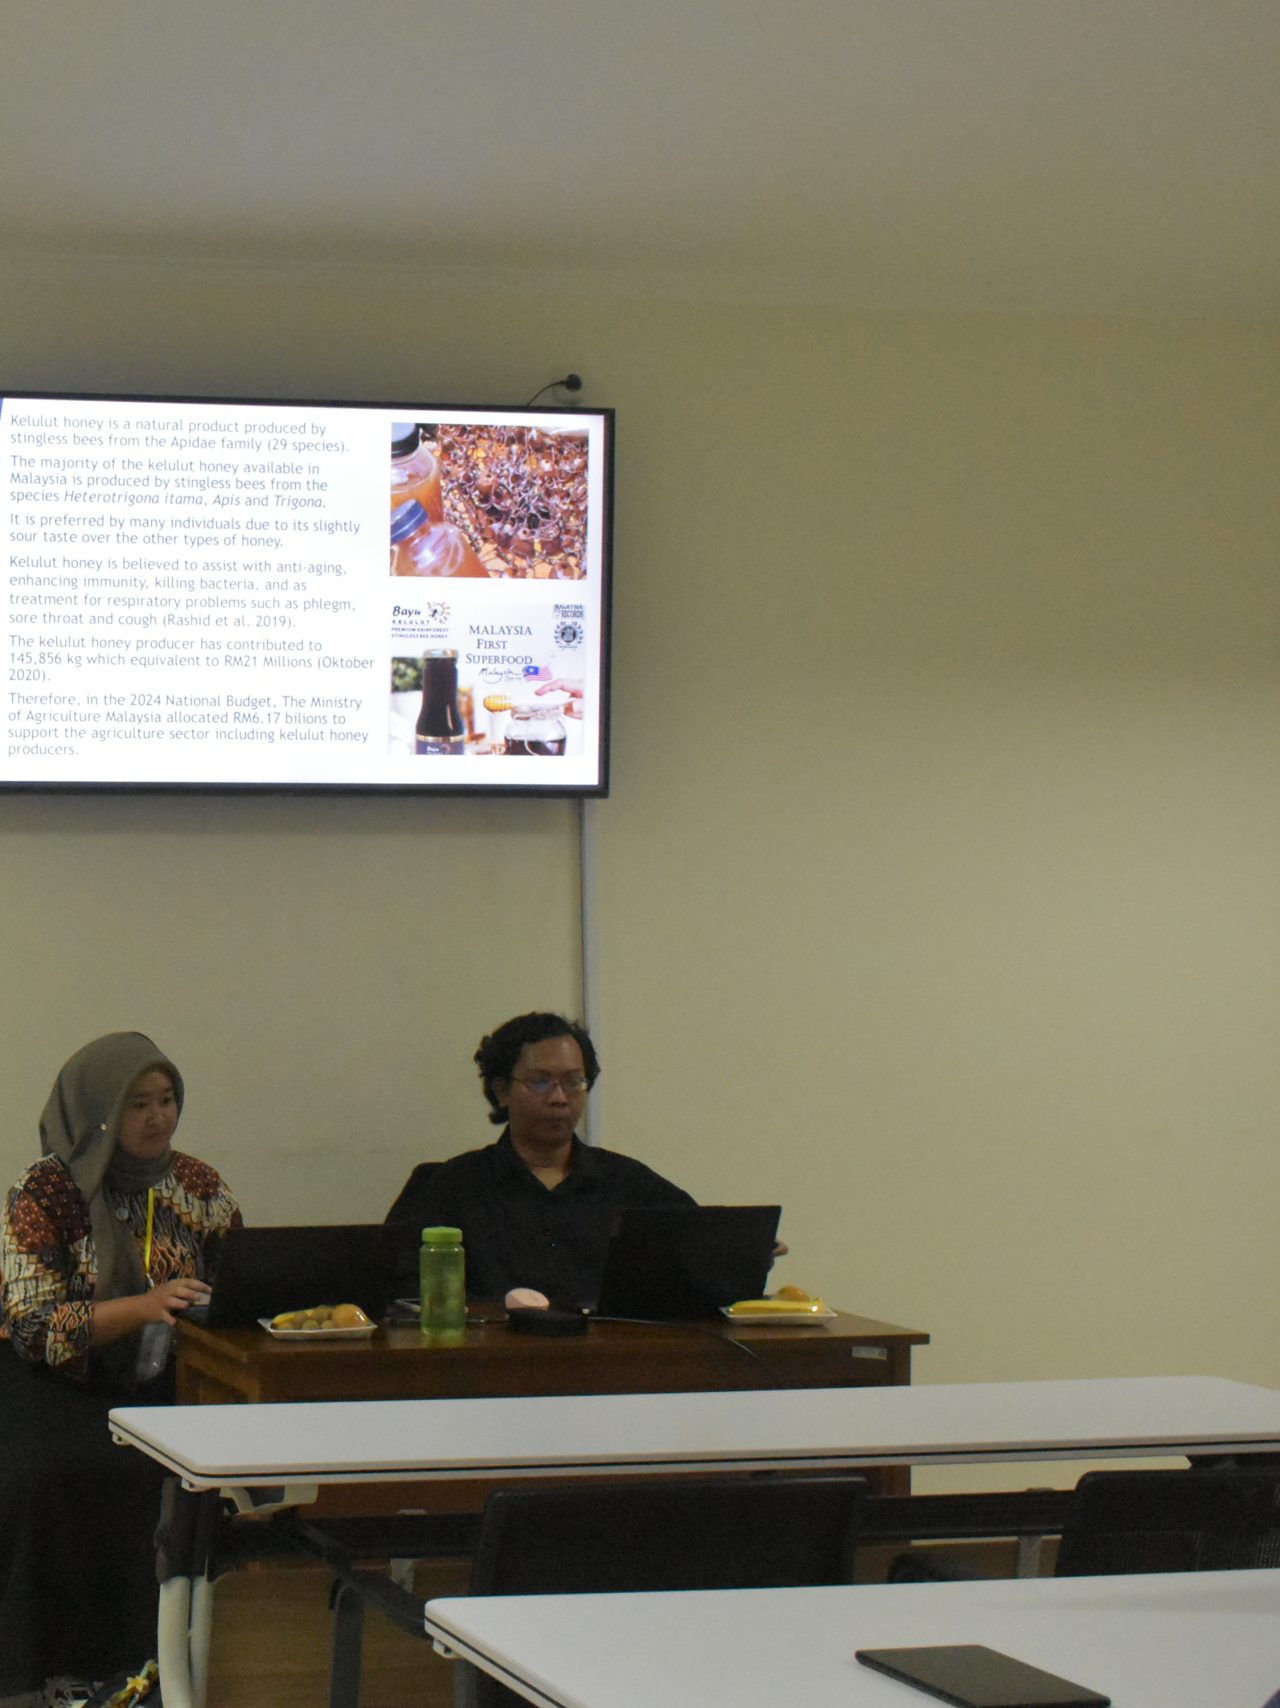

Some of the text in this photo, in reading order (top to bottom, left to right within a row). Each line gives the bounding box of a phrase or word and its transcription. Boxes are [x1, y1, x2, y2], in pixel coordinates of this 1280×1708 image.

[10, 414, 326, 438] Kelulut honey is a natural product produced by
[10, 431, 350, 455] stingless bees from the Apidae family (29 species).
[10, 455, 320, 475] The majority of the kelulut honey available in
[9, 472, 328, 492] Malaysia is produced by stingless bees from the
[9, 489, 327, 511] species Heterotrigona itama, Apis and Trigona.
[10, 513, 360, 535] It is preferred by many individuals due to its slightly
[9, 532, 284, 550] sour taste over the other types of honey.
[9, 556, 347, 576] Kelulut honey is believed to assist with anti-aging,
[9, 574, 307, 592] enhancing immunity, killing bacteria, and as
[9, 594, 355, 613] treatment for respiratory problems such as phlegm,
[392, 605, 421, 617] Bayu
[9, 612, 296, 629] sore throat and cough (Rashid et al. 2019).
[469, 625, 532, 636] MALAYSIA
[9, 635, 322, 652] The kelulut honey producer has contributed to
[477, 638, 508, 649] FIRST
[10, 652, 376, 670] 145,856 kg which equivalent to RM21 Millions (Oktober
[465, 653, 533, 665] SUPERFOOD
[9, 669, 51, 683] 2020).
[8, 692, 363, 711] Therefore, in the 2024 National Budget, The Ministry
[7, 709, 346, 725] of Agriculture Malaysia allocated RM6.17 bilions to
[7, 727, 369, 744] support the agriculture sector including kelulut honey
[7, 743, 79, 758] producers.
